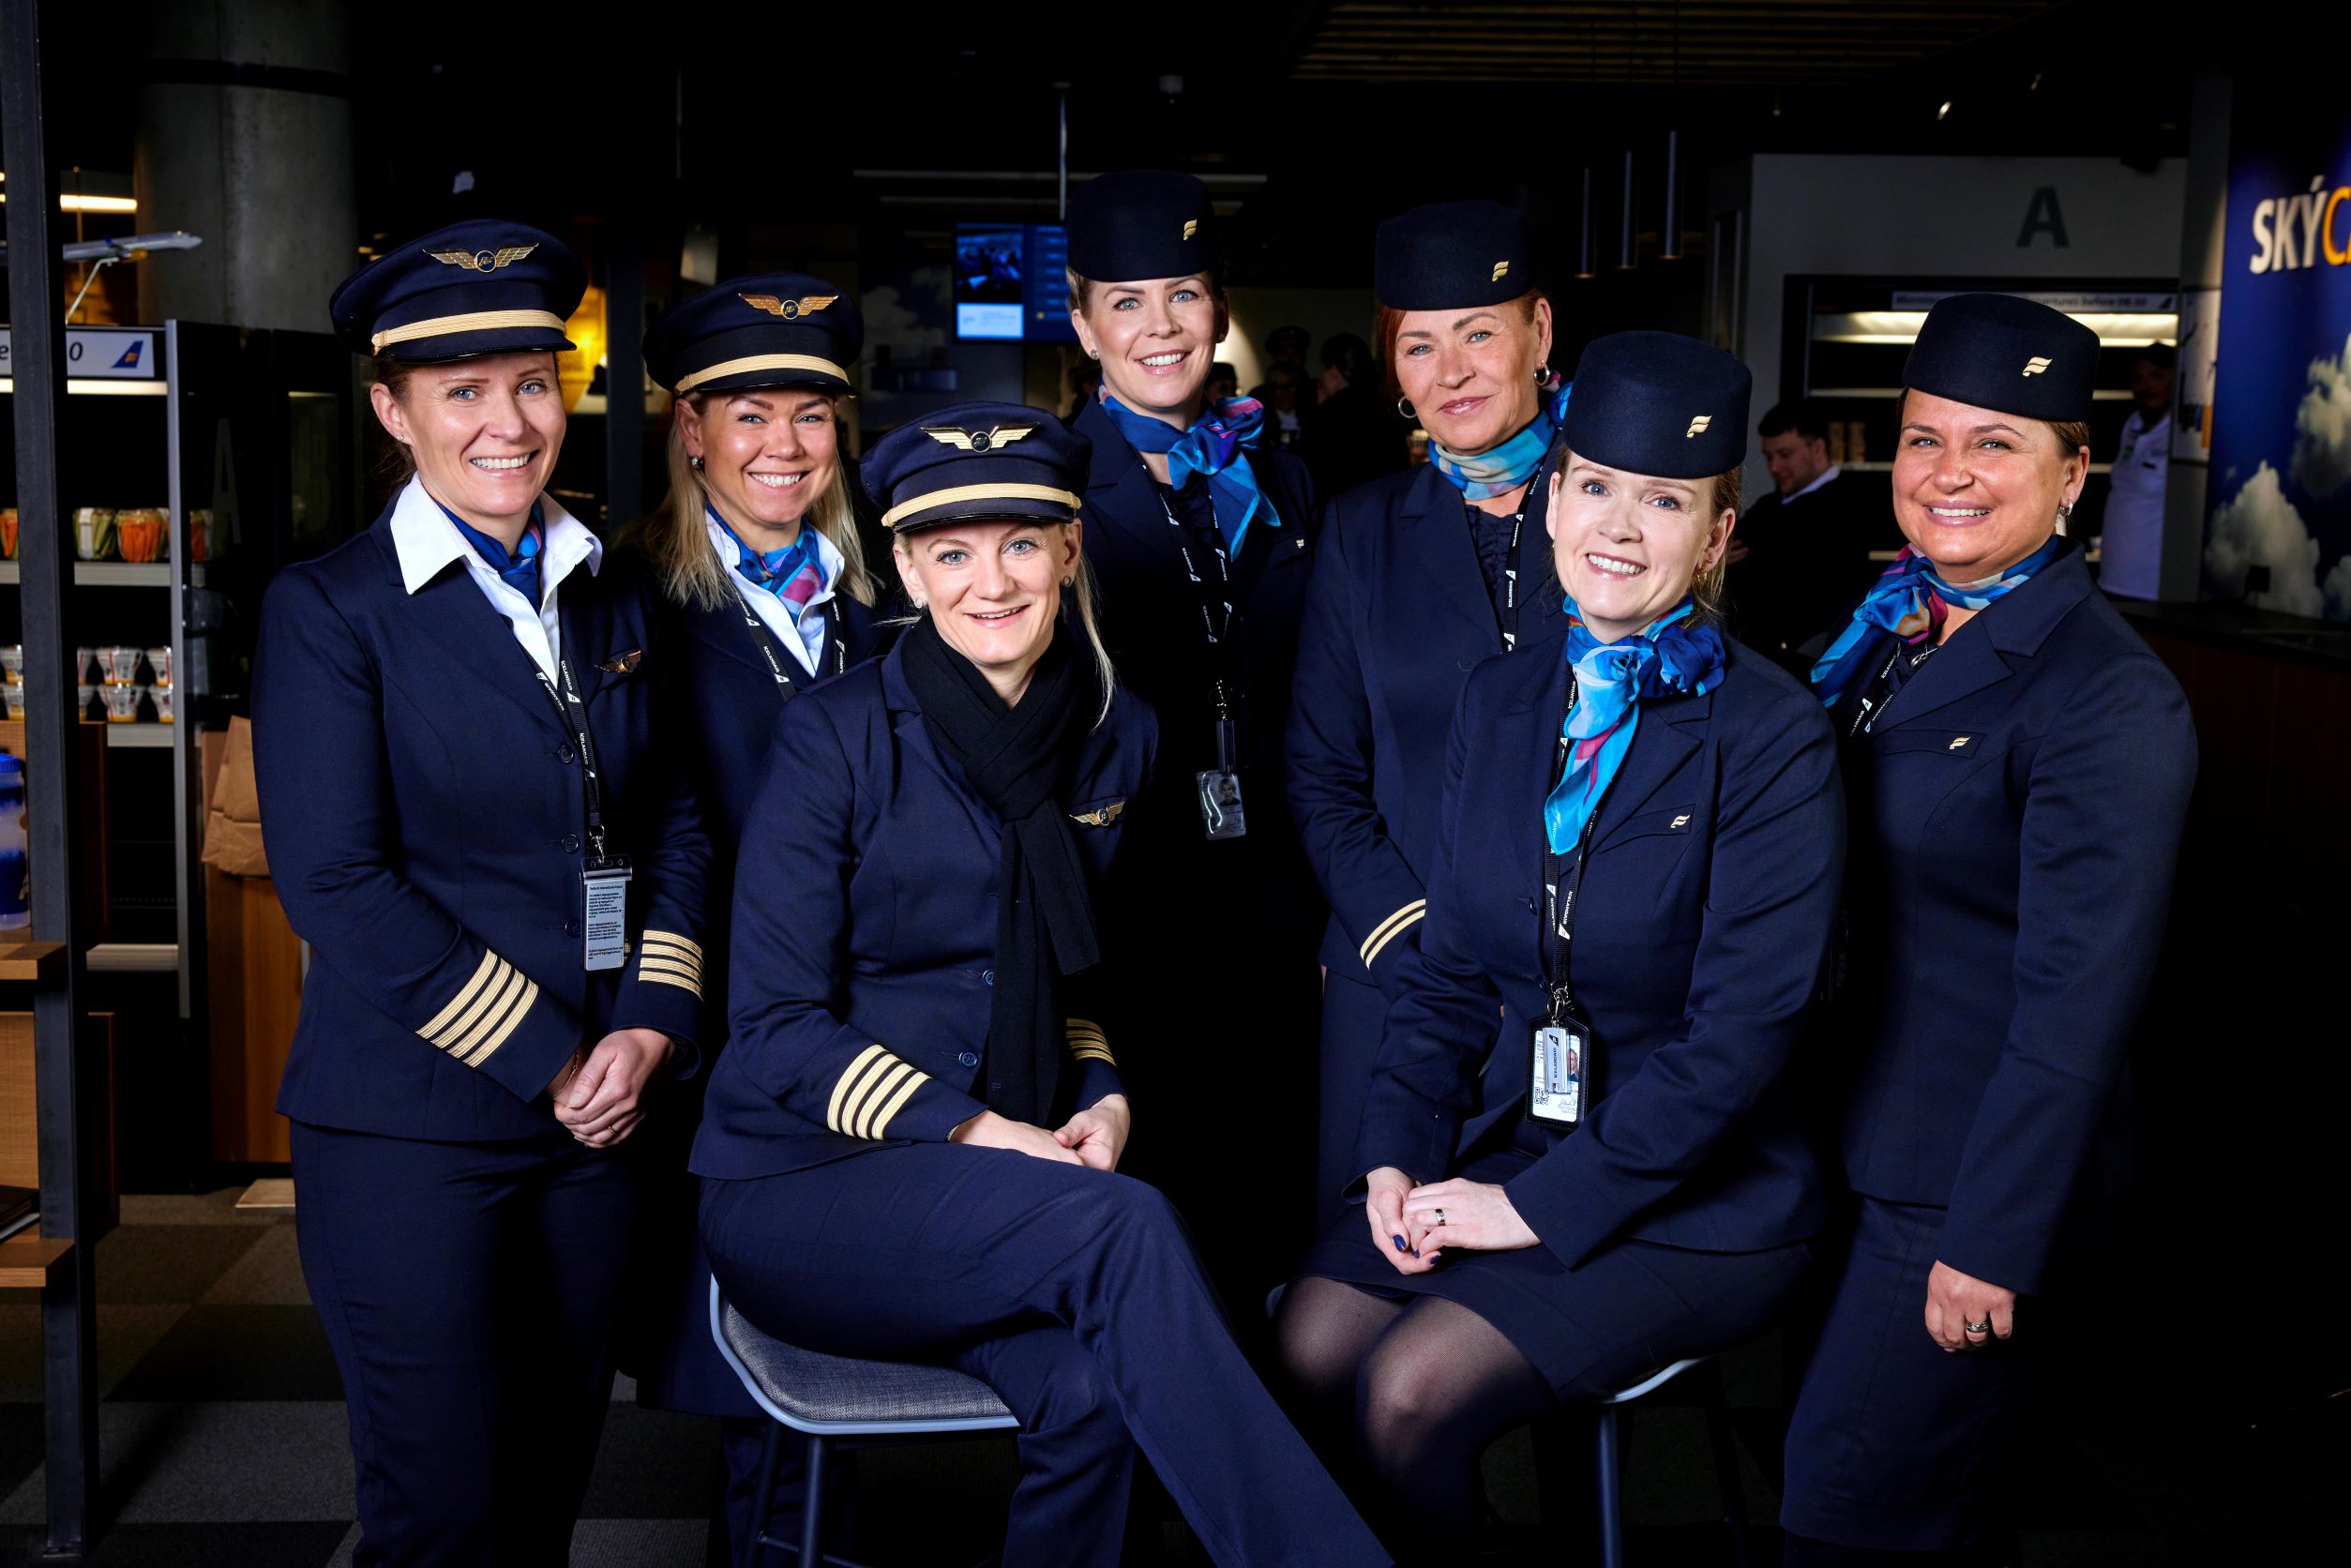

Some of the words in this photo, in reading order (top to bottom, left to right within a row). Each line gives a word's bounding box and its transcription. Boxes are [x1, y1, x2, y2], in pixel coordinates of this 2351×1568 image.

[2017, 187, 2069, 247] A
[2249, 174, 2351, 275] SKÝC
[561, 659, 573, 691] ICELANDAIR
[763, 645, 780, 672] ICELANDAIR
[579, 732, 589, 765] ICELANDAIR
[1561, 891, 1575, 925] ICELANDAIR
